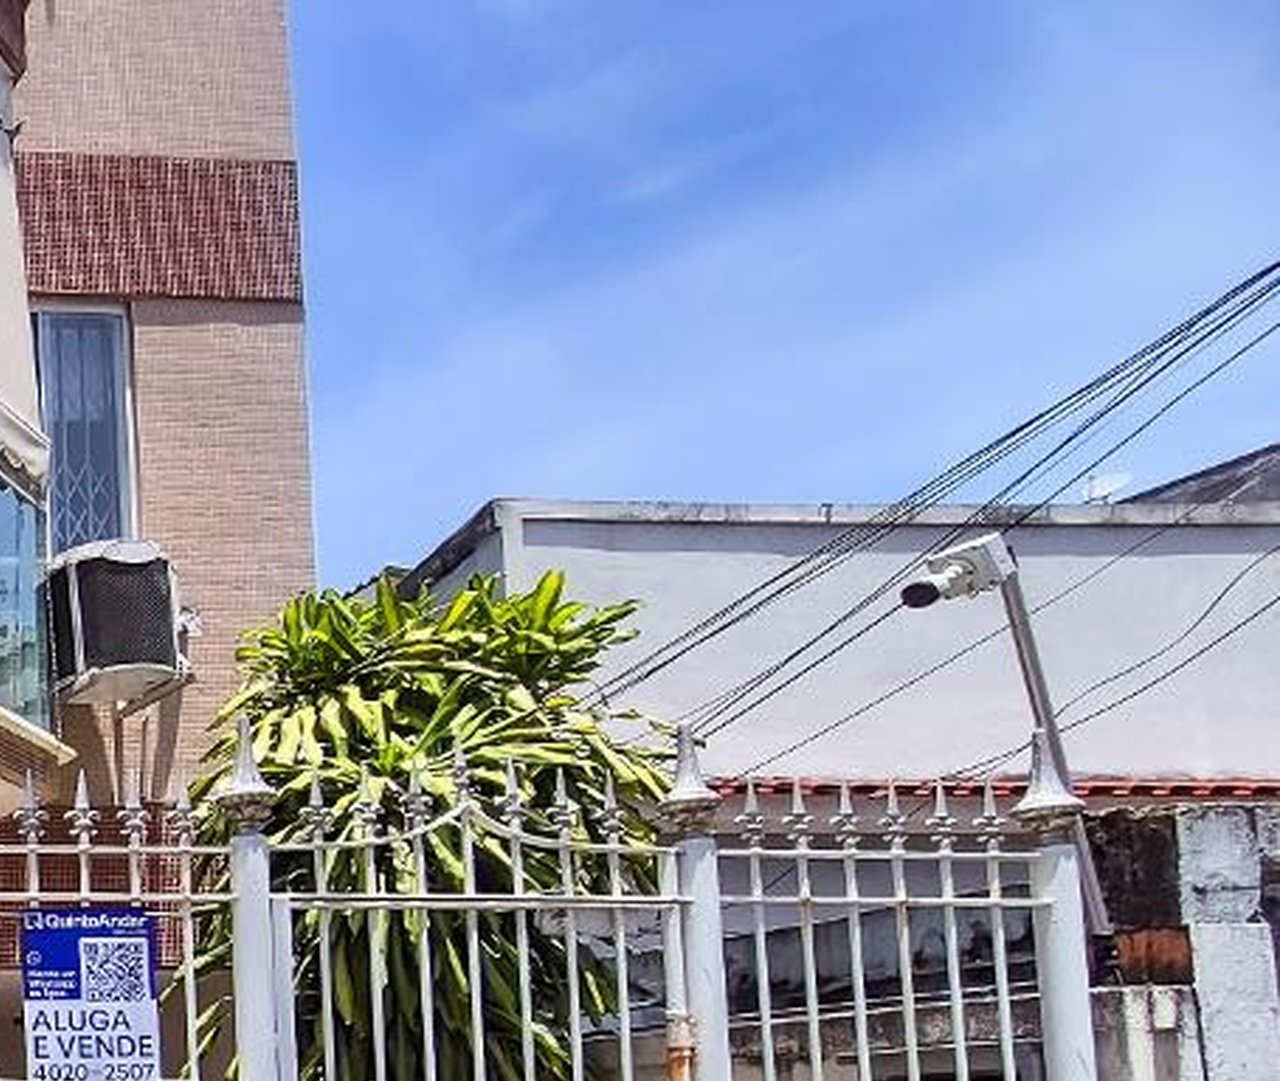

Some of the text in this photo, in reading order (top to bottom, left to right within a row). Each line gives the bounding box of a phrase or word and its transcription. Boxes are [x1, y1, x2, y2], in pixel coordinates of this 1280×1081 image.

[32, 1010, 131, 1031] ALUGA
[34, 1035, 154, 1059] E VENDE
